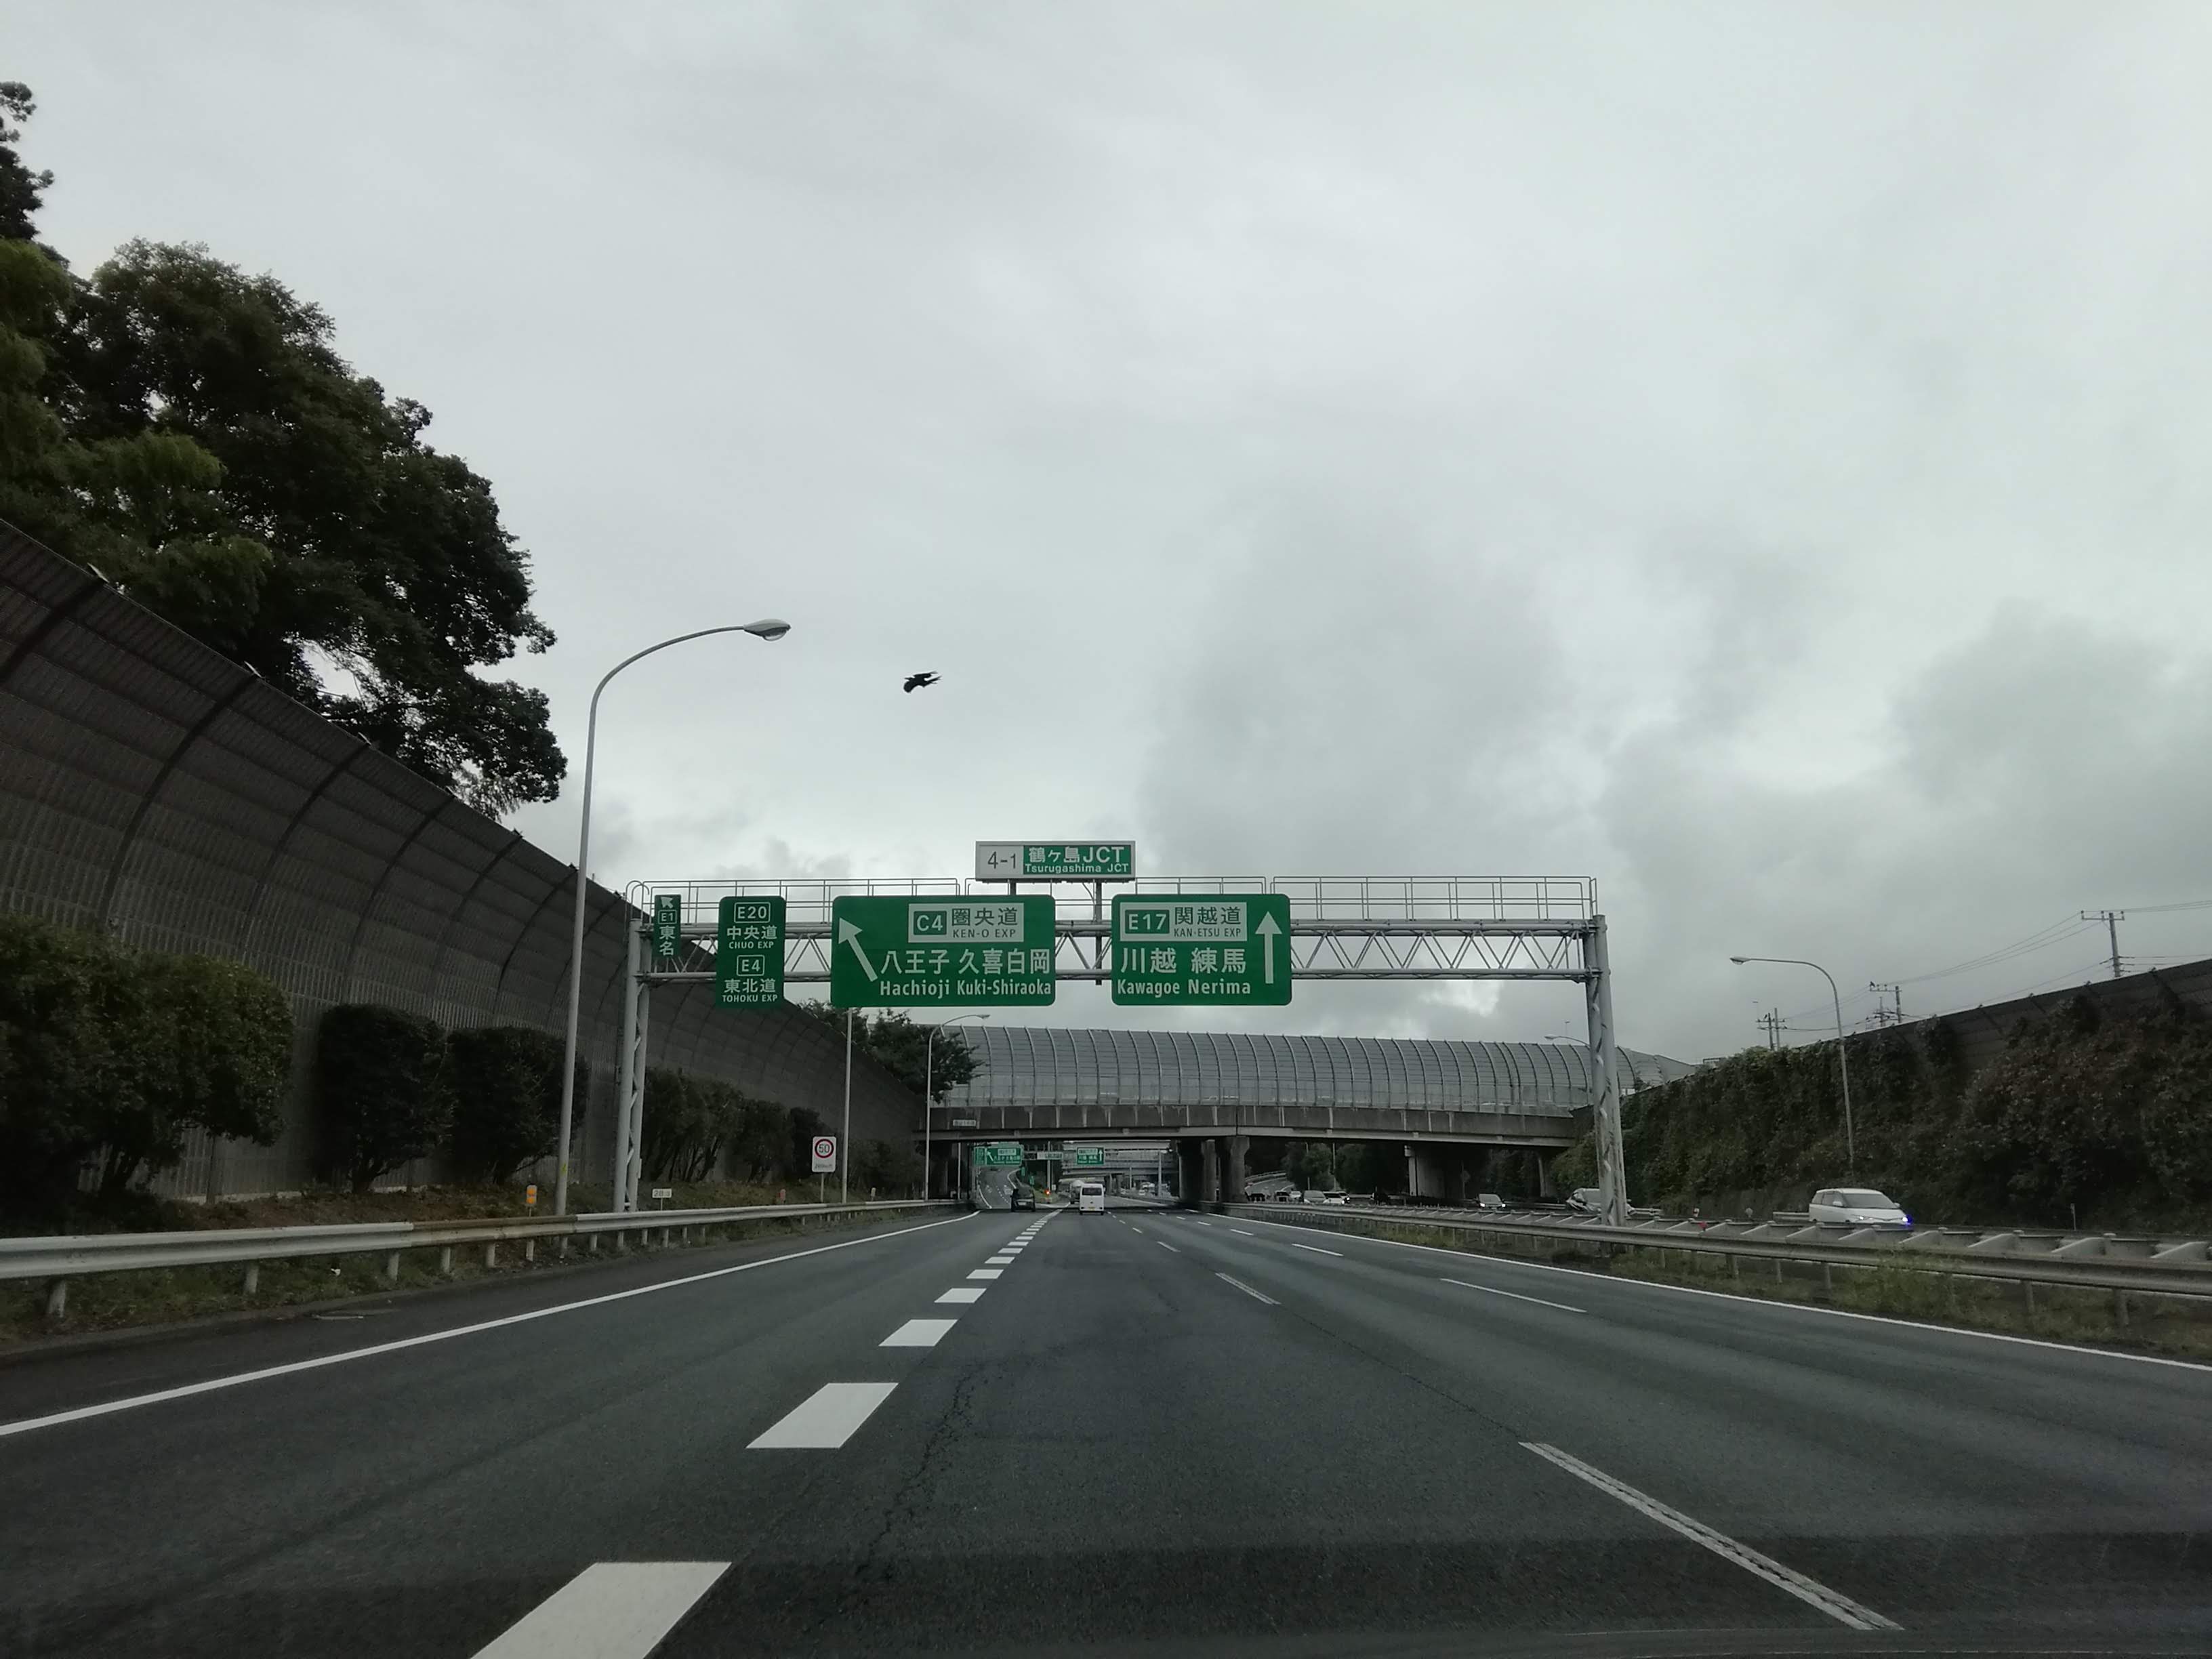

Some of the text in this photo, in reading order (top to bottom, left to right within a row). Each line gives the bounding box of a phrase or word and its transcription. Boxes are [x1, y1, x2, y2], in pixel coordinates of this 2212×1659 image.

[987, 851, 1017, 869] 4-1
[1025, 863, 1129, 874] Tsurugashima JCT
[661, 912, 674, 922] E1
[737, 905, 767, 920] E20
[951, 907, 1018, 926] 圏央道
[1174, 906, 1242, 926] 関越道
[916, 914, 943, 932] C4
[1128, 913, 1167, 930] E17
[659, 925, 676, 956] 東名
[726, 924, 777, 941] 中央道
[952, 928, 1017, 939] KEN-O EXP
[1174, 928, 1242, 937] KAN-ETSU EXP
[729, 941, 774, 949] CHUO EXP
[741, 959, 761, 972] E4
[880, 947, 1050, 975] 八王子 久喜白岡
[1120, 947, 1246, 974] 川越 練馬
[724, 978, 776, 994] 東北道
[880, 979, 1051, 1000] Hachioji Kuki-Shiraoka
[1117, 977, 1251, 998] Kawagoe Nerima
[722, 994, 778, 1002] TOHOKU EXP
[819, 1143, 831, 1153] 50
